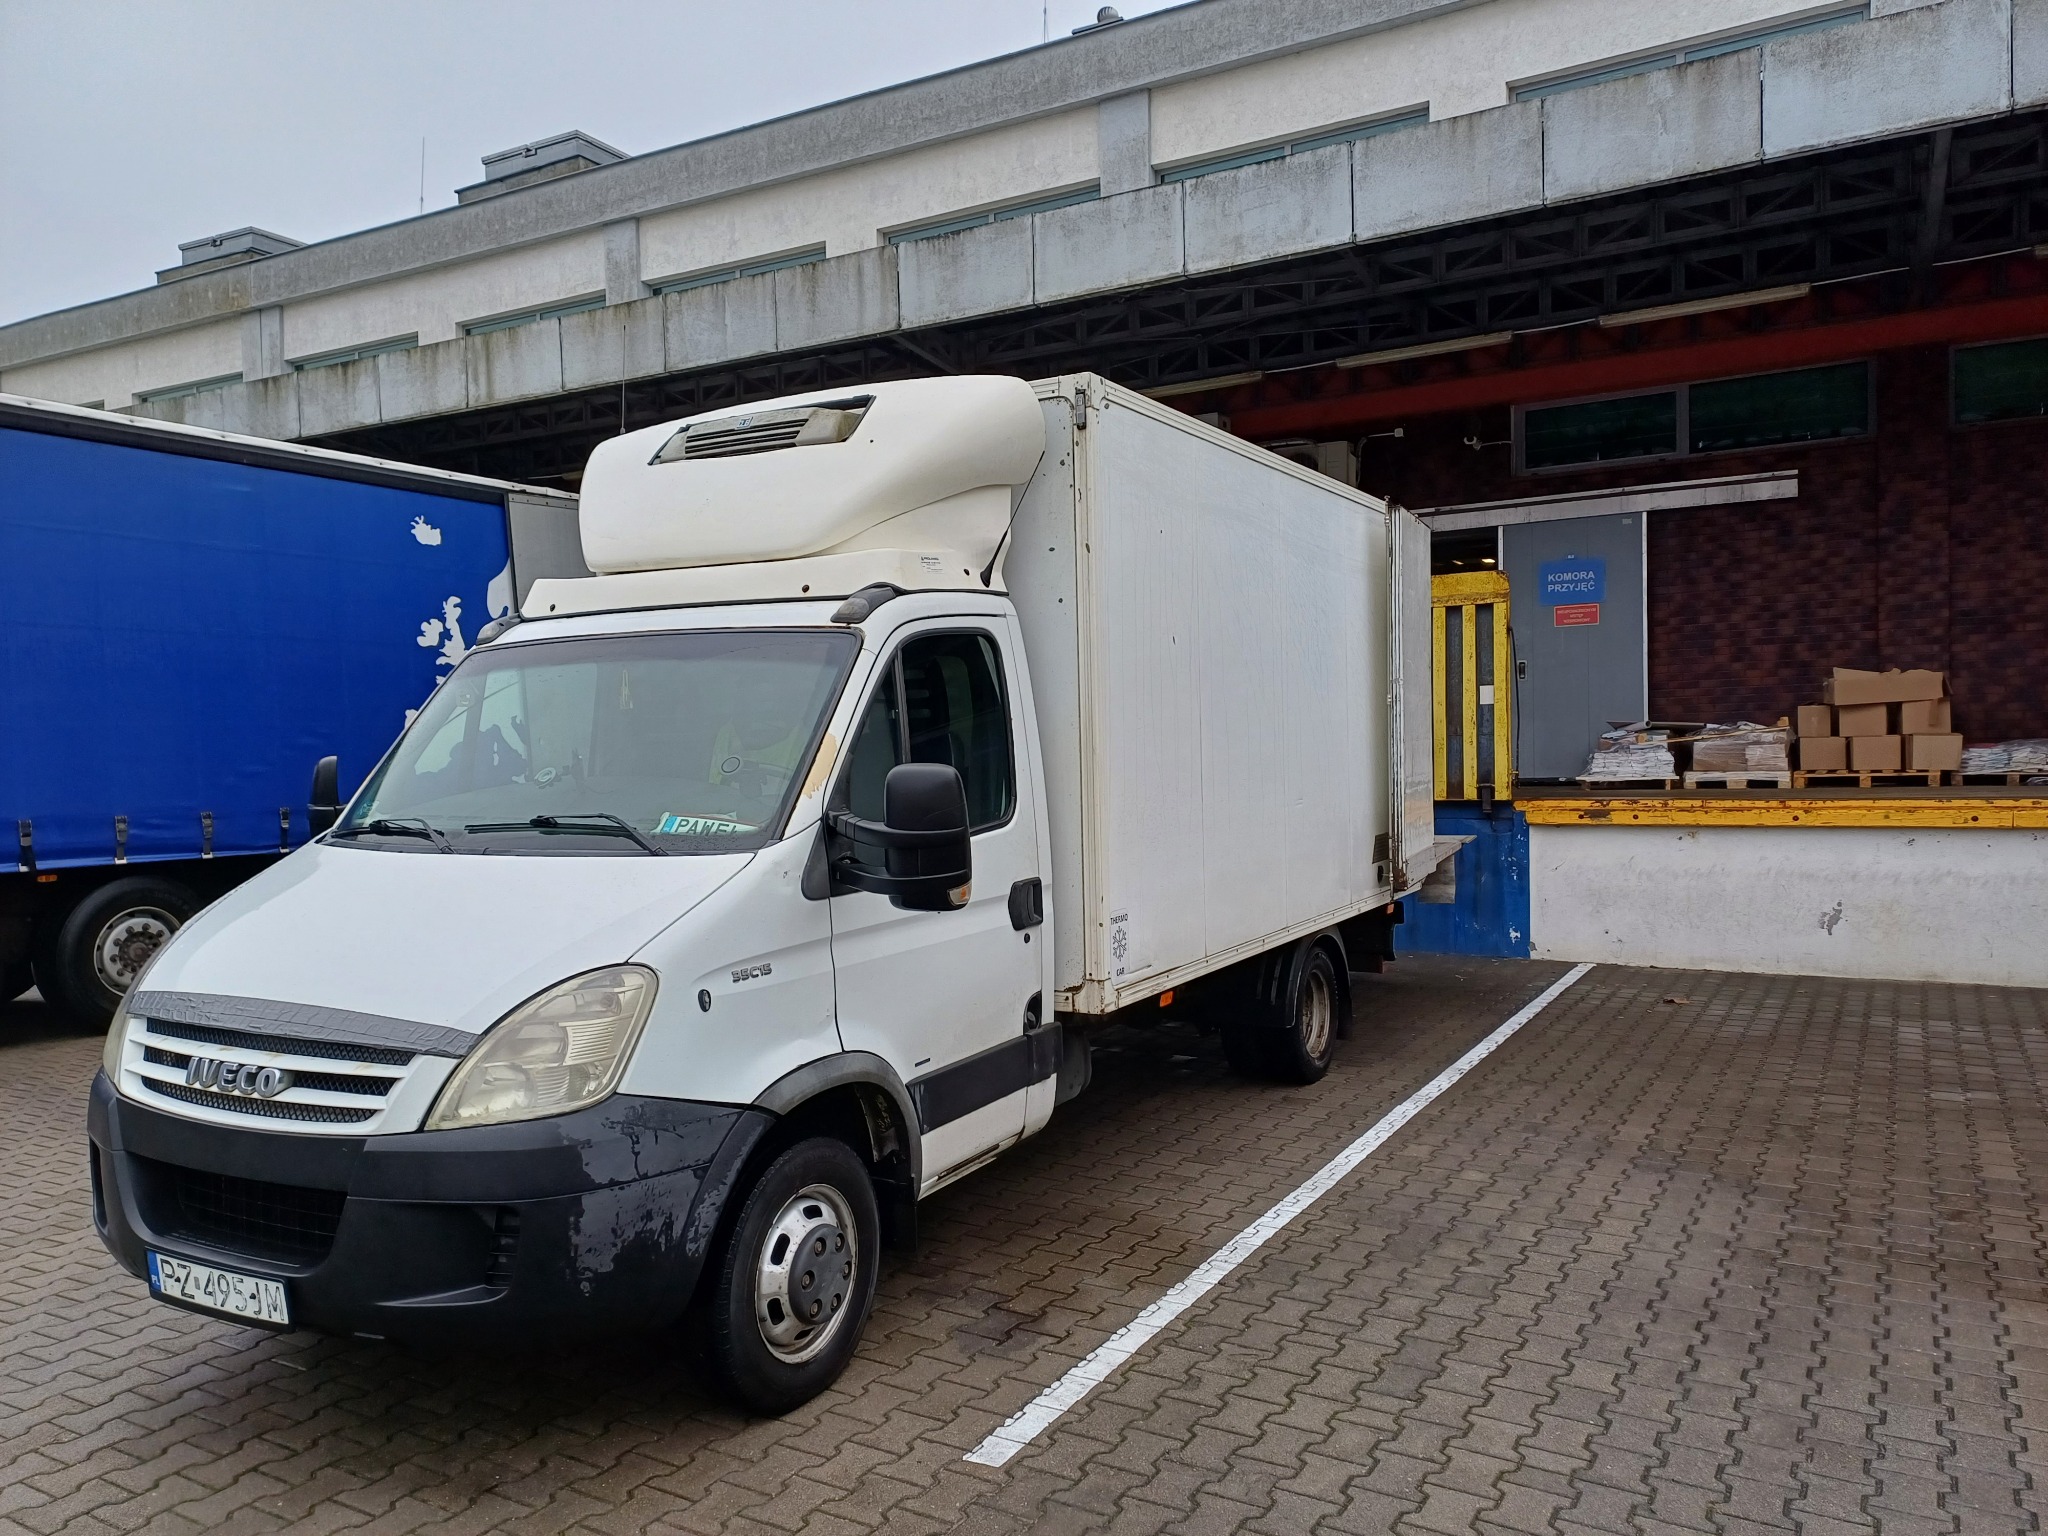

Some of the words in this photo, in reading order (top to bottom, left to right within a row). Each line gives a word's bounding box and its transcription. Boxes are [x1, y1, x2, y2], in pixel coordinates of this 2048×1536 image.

[1548, 571, 1595, 582] KOMORA
[1548, 580, 1595, 592] PRZYJĘĆ
[1110, 913, 1129, 926] THERMO
[731, 963, 773, 984] 35C15
[1116, 966, 1125, 977] CAR
[185, 1056, 283, 1099] IVECO
[151, 1276, 160, 1286] PL
